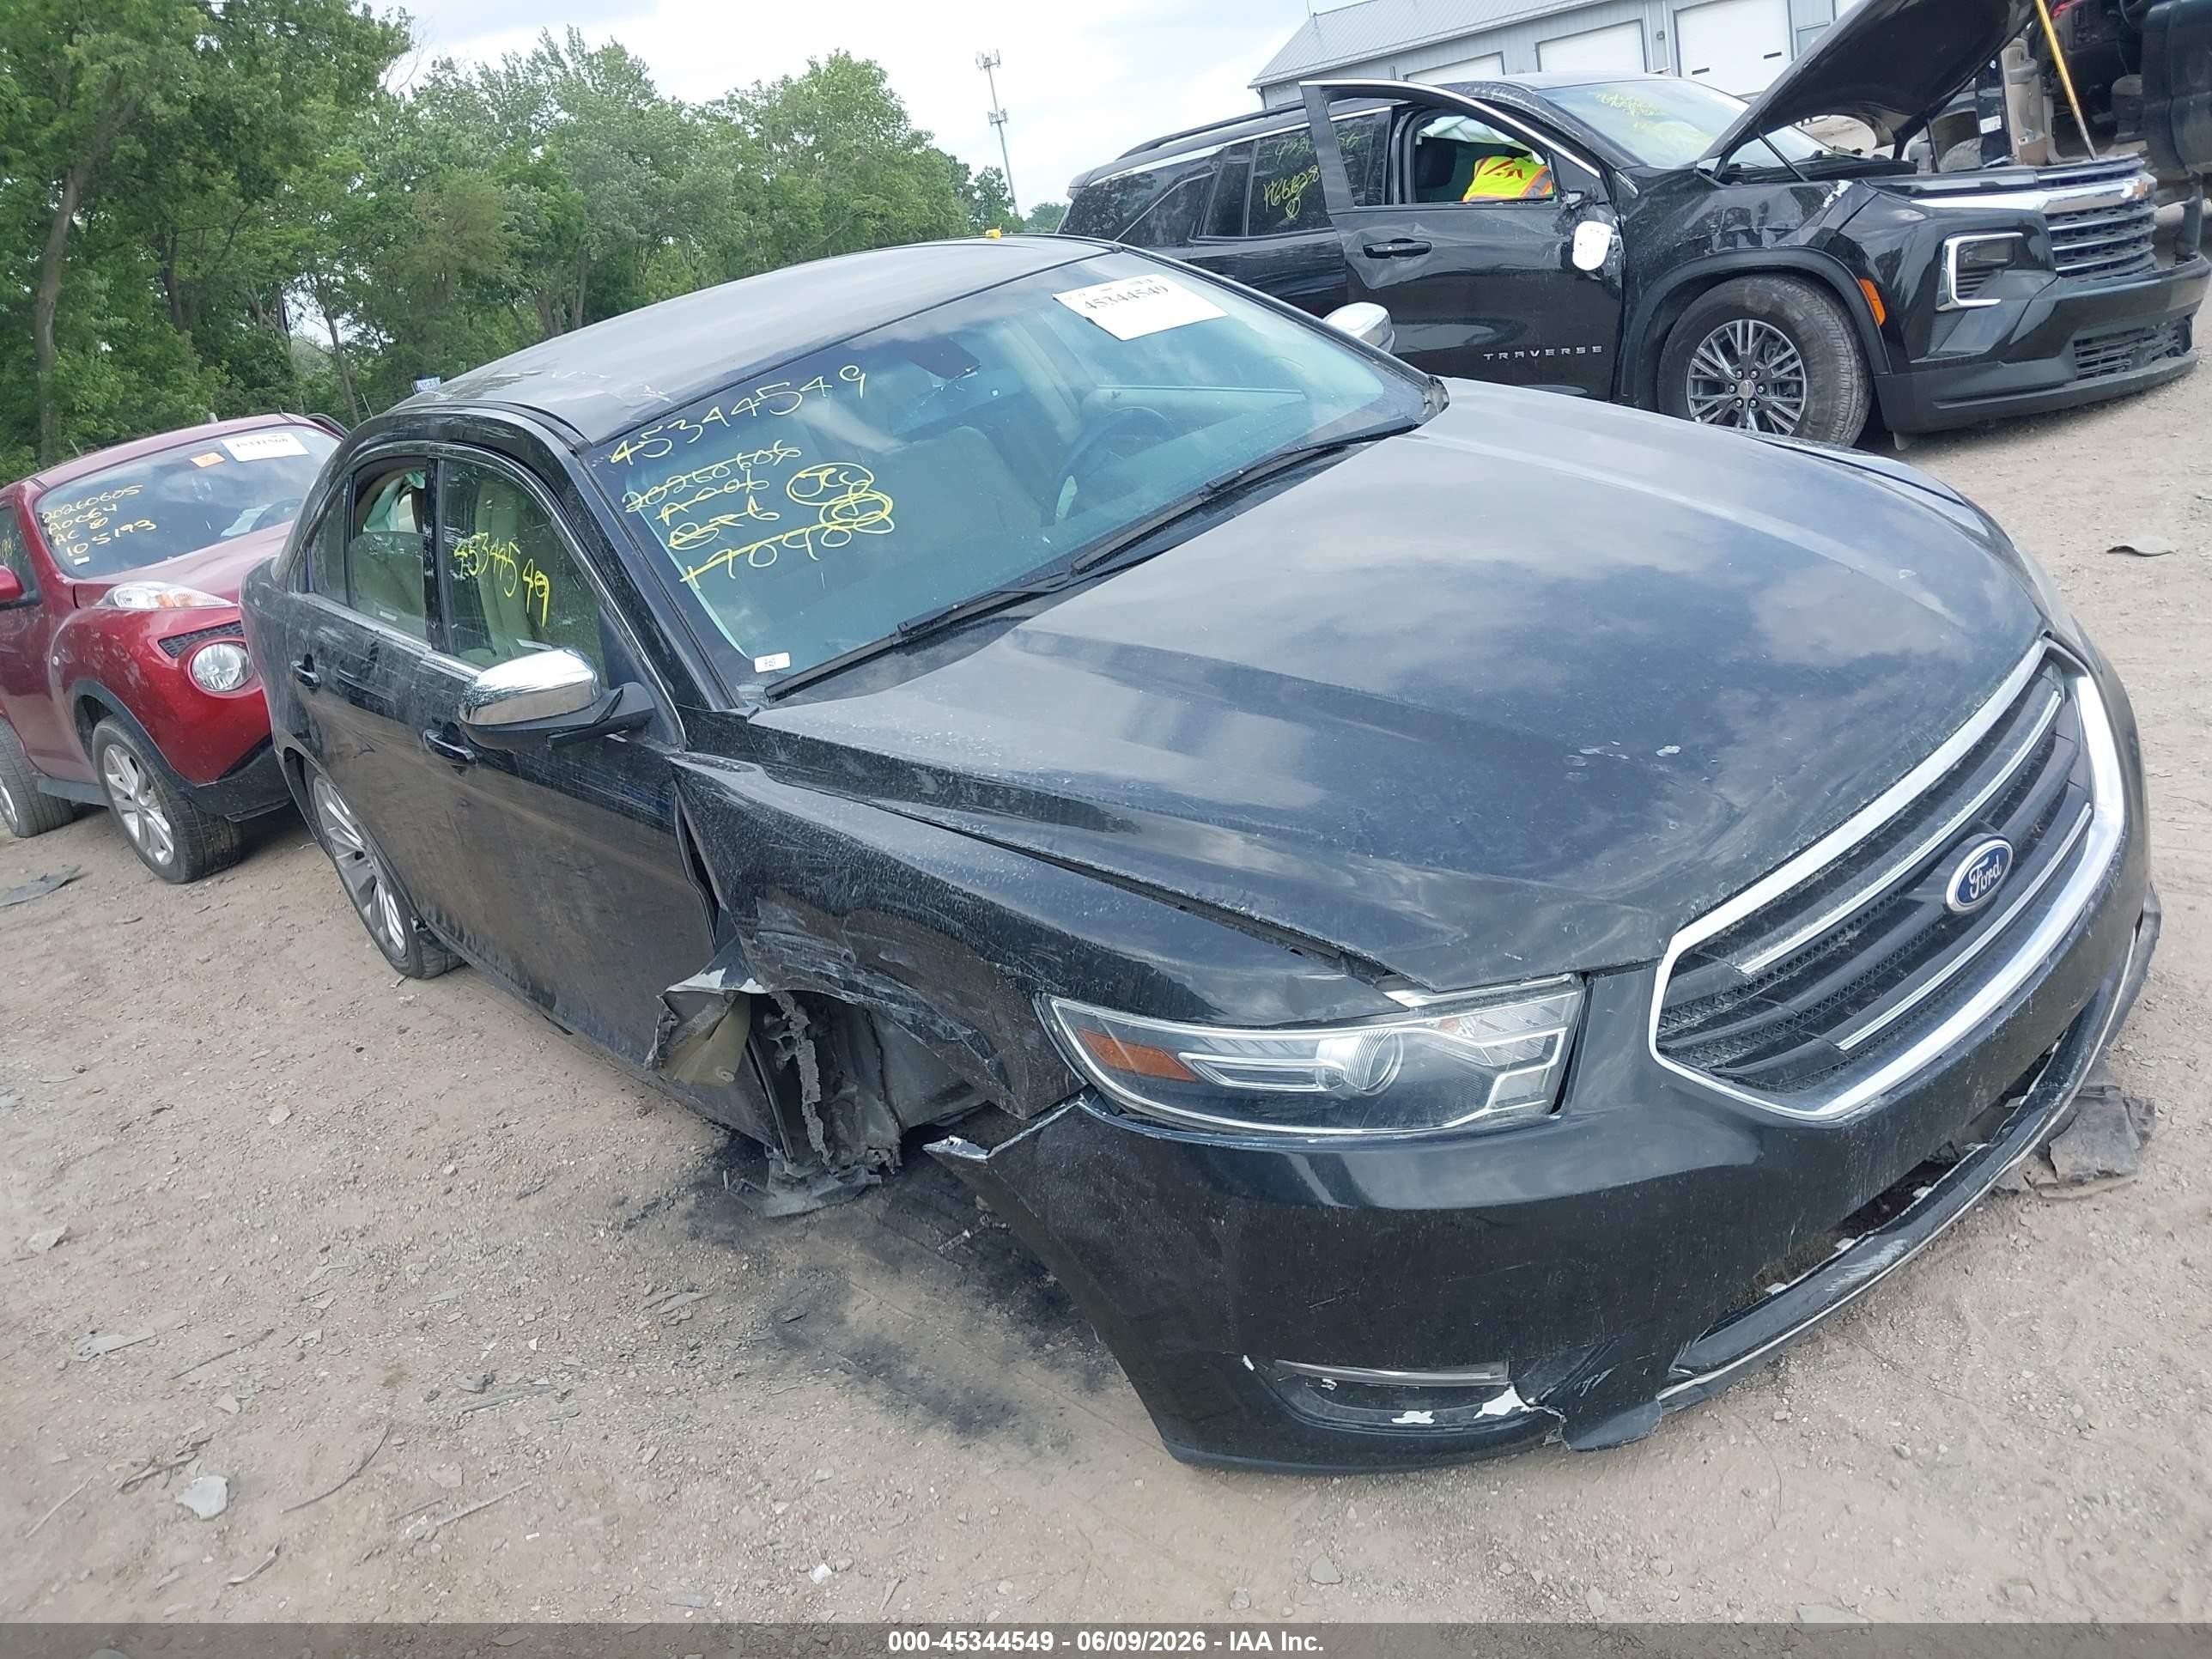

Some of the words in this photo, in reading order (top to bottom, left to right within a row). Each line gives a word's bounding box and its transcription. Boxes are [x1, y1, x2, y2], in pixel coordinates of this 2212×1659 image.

[1085, 285, 1169, 310] 45344549
[1483, 345, 1602, 361] TRAVERSE
[610, 365, 866, 466] 45344549
[41, 484, 143, 524] 20260605
[1968, 854, 2002, 900] Ford
